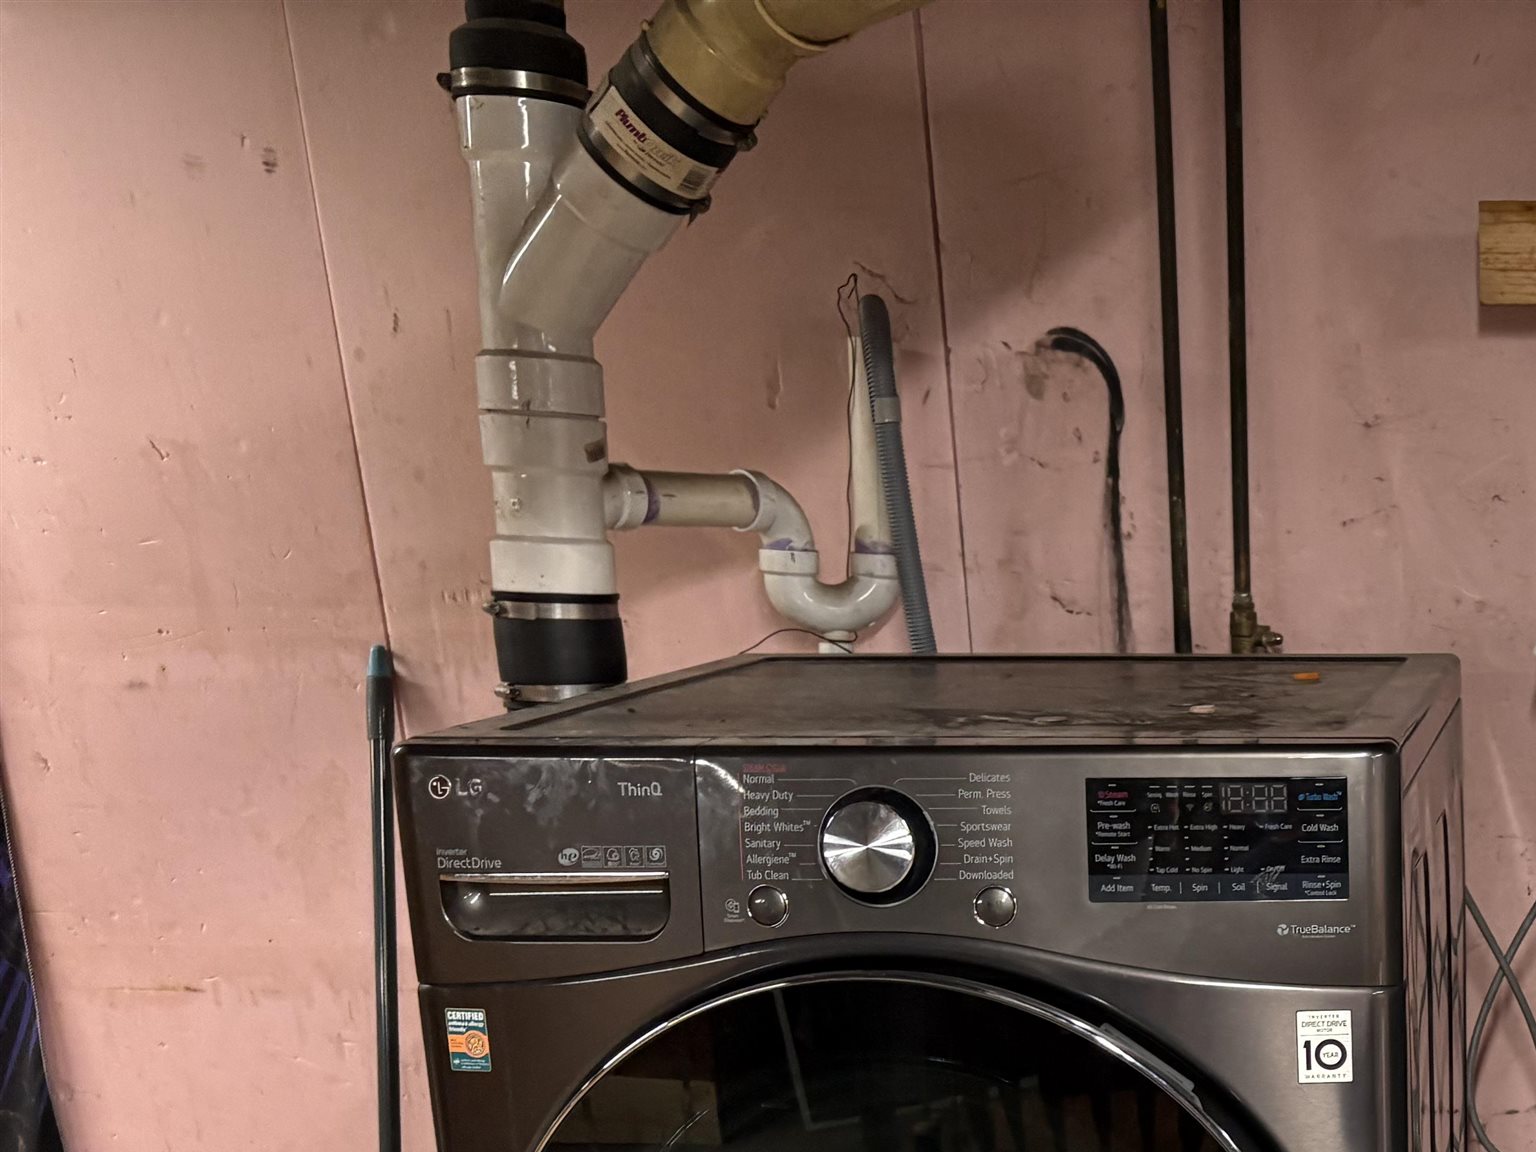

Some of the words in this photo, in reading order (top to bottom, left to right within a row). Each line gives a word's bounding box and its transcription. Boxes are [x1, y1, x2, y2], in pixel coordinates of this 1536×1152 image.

[743, 774, 775, 784] Normal
[969, 772, 1012, 783] Delicates
[456, 778, 482, 796] LG
[617, 782, 663, 797] ThinQ
[743, 790, 769, 802] Heavy
[772, 789, 794, 802] Duty
[986, 788, 1012, 799] Press
[743, 806, 779, 818] Bedding
[981, 805, 1013, 815] Towels
[744, 822, 771, 834] Bright
[960, 821, 1012, 834] Sportswear
[1097, 821, 1131, 830] Pre-wash
[1301, 823, 1318, 832] Cold
[1320, 823, 1339, 831] Wash
[745, 838, 781, 851] Sanitary
[958, 838, 986, 850] Speed
[988, 838, 1013, 848] Wash
[1095, 854, 1115, 863] Delay
[1116, 854, 1136, 862] Wash
[1301, 855, 1320, 863] Extra
[1321, 855, 1341, 863] Rinse
[747, 870, 762, 880] Tub
[764, 870, 789, 880] Clean
[959, 870, 1014, 880] Downloaded
[1101, 884, 1115, 892] Add
[1117, 884, 1134, 892] Item
[1192, 883, 1208, 893] Spin
[1232, 883, 1245, 891] Soil
[1266, 882, 1288, 892] Signal
[447, 1011, 484, 1020] CERTIFIED
[1303, 1039, 1348, 1071] 10
